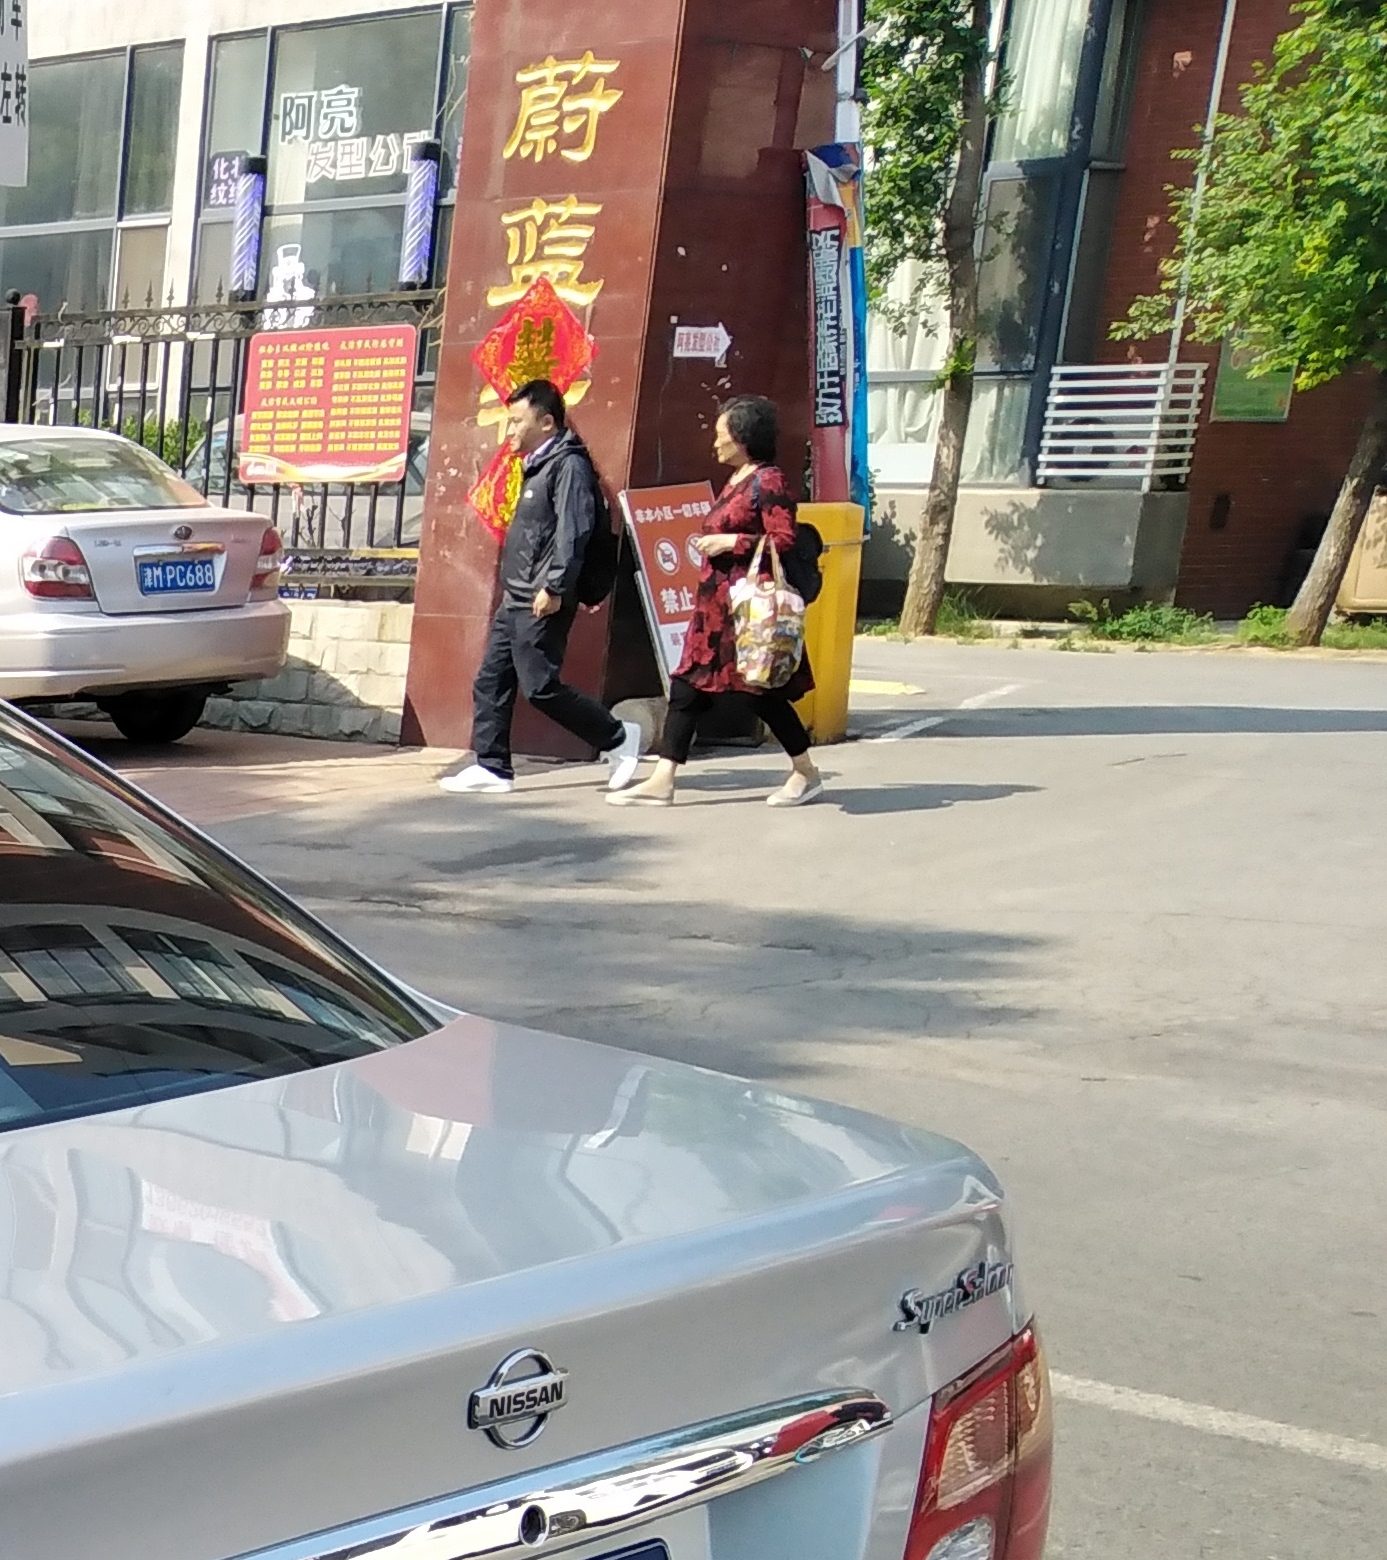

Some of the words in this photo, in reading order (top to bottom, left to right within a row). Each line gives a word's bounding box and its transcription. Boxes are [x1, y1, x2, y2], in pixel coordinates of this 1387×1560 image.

[280, 84, 361, 146] 阿亮
[810, 229, 845, 426] 致力于居家养老消费服务
[488, 1380, 564, 1419] NISSAN
